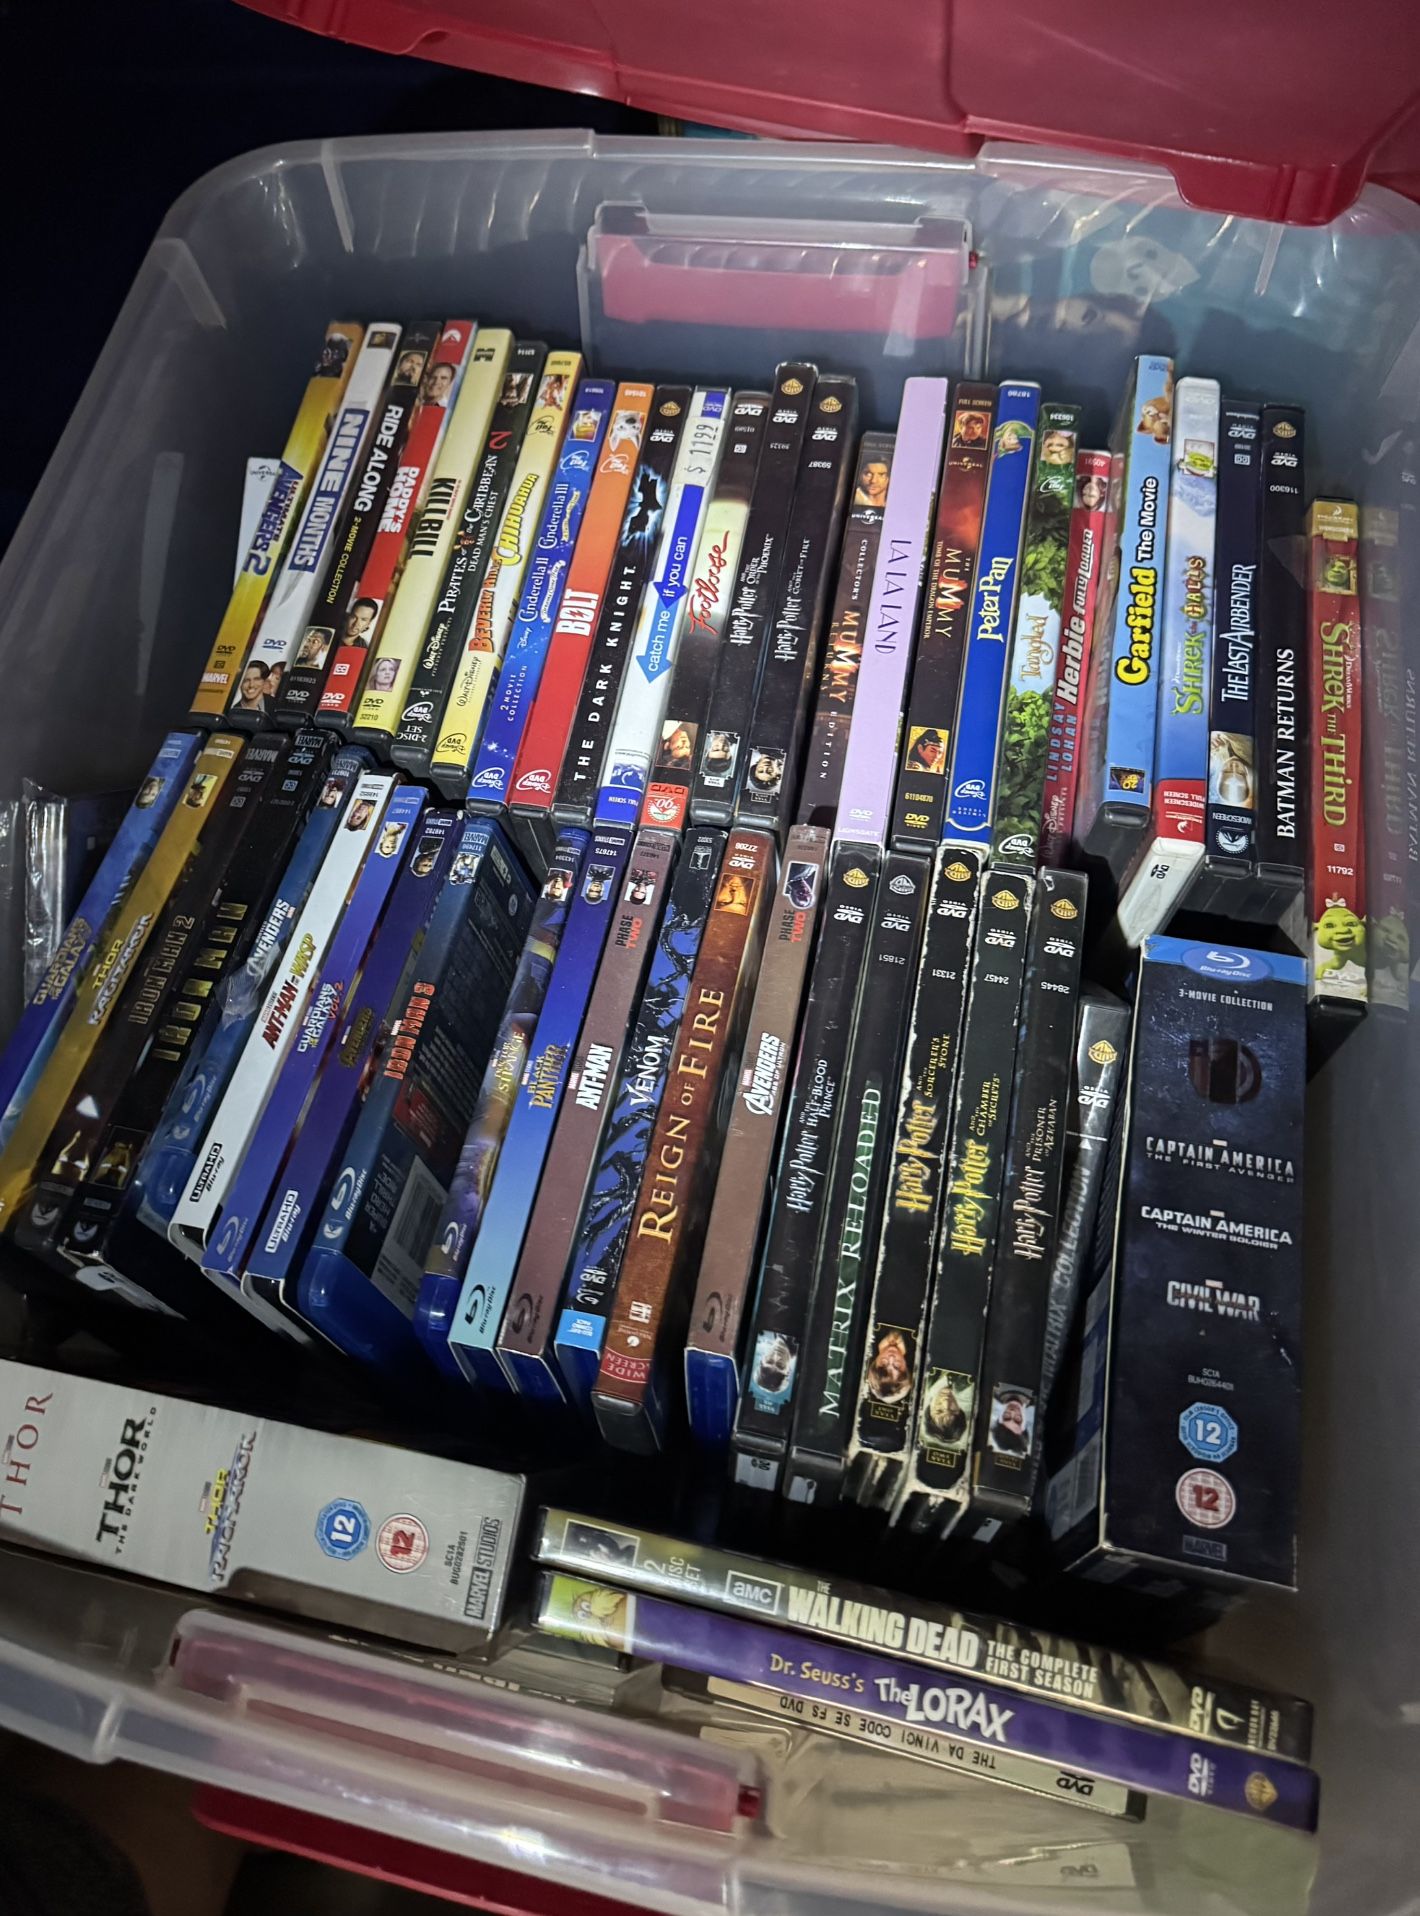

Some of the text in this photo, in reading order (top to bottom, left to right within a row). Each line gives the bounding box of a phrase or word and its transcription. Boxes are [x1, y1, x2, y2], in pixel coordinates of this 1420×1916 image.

[292, 413, 366, 567] NINE MONTHS
[353, 405, 403, 512] RIDE ALONG
[1269, 484, 1299, 495] 116300
[243, 461, 303, 576] AVENGERS 2
[423, 477, 457, 519] KILL
[467, 491, 499, 572] DEAD MAN'S CHEST
[538, 495, 566, 549] Cinderella
[326, 516, 362, 604] 2-MOVIE COLLECTION
[409, 519, 441, 557] BILL
[438, 556, 469, 614] PIRATES
[464, 455, 498, 523] CARIBBEAN
[468, 473, 540, 653] BEVERLY CHIHUAHUA
[519, 567, 546, 623] Cinderella
[648, 536, 688, 672] catch me if you can
[688, 530, 730, 636] Footloose
[851, 539, 868, 602] COLLECTOR'S
[874, 539, 912, 655] LA LA LAND
[934, 547, 969, 639] MUMMY
[976, 556, 1014, 643] Peter Pan
[1115, 476, 1160, 686] Garfield The Movie
[1183, 555, 1211, 620] HALLS
[556, 589, 600, 637] BOLT
[1057, 529, 1094, 704] Herbie FULLY LOADED
[1219, 563, 1257, 649] AIRBENDER
[574, 566, 637, 781] THE DARK KNIGHT
[819, 622, 838, 691] RETURNS
[828, 611, 863, 703] MUMMY
[1019, 613, 1054, 682] Tangled
[1169, 629, 1206, 716] SHREK
[508, 665, 527, 722] COLLECTION
[1320, 621, 1351, 828] SHREK THE THIRD
[396, 731, 428, 743] 2-DISC
[818, 711, 839, 779] EDITION
[1046, 703, 1066, 782] LINDSAY
[1061, 714, 1078, 772] LOHAN
[1276, 648, 1296, 839] BATMAN RETURNS
[650, 783, 687, 795] DVD
[1212, 813, 1252, 825] WIDESCREEN
[1326, 864, 1354, 877] 11792
[194, 902, 248, 970] MAN
[289, 932, 317, 979] WASP
[614, 915, 644, 950] PHASE TWO
[779, 908, 808, 944] PHASE TWO
[878, 953, 906, 965] 21851
[87, 912, 154, 1025] RAGNAROK
[92, 939, 125, 990] THOR
[128, 915, 195, 1025] IRON MAN 2
[931, 968, 956, 980] 21331
[984, 974, 1010, 985] 24457
[1039, 980, 1071, 994] 28445
[260, 978, 300, 1051] ANT-MAN
[297, 983, 334, 1053] GUARDIANS
[1178, 987, 1273, 1012] 3-MOVIE COLLECTION
[383, 996, 431, 1081] IRON MAN
[625, 1034, 667, 1107] VENOM
[938, 1033, 951, 1069] STONE
[530, 1045, 568, 1109] PANTHER
[575, 1043, 614, 1111] ANT-MAN
[742, 1031, 782, 1116] AVENGERS
[818, 1081, 835, 1119] PRINCE
[637, 987, 725, 1245] REIGN OF FIRE
[786, 1058, 829, 1214] Harry Potter HALF-BLOOD
[895, 1036, 940, 1213] Harry Potter SORCERER'S
[1043, 1098, 1058, 1151] AZKABAN
[950, 1080, 993, 1256] Harry Potter CHAMBER
[1013, 1107, 1054, 1261] Harry Potter PRISONER
[1145, 1135, 1296, 1177] CAPTAIN AMERICA
[1145, 1152, 1296, 1184] THE FIRST AVENGER
[818, 1087, 882, 1418] MATRIX RELOADED
[1140, 1205, 1294, 1246] CAPTAIN AMERICA
[1155, 1221, 1279, 1251] THE WINTER SOLDIER
[1166, 1280, 1261, 1322] CIVIL WAR
[0, 1391, 55, 1516] THOR
[1195, 1418, 1222, 1446] 12
[96, 1418, 147, 1543] THOR
[115, 1405, 158, 1555] THE DARK WORLD
[203, 1467, 232, 1535] THOR
[210, 1430, 258, 1582] RAGNAROK
[1191, 1484, 1221, 1513] 12
[330, 1514, 356, 1545] 12
[389, 1529, 416, 1558] 12
[464, 1516, 500, 1620] MARVEL STUDIOS
[816, 1580, 831, 1594] THE
[787, 1585, 980, 1669] WALKING DEAD
[986, 1639, 1099, 1684] THE COMPLETE
[769, 1653, 1016, 1743] Dr. Seuss's The LORAX
[984, 1658, 1094, 1699] FIRST SEASON
[779, 1695, 997, 1770] THE DA VINCI CODE SE FS DVD
